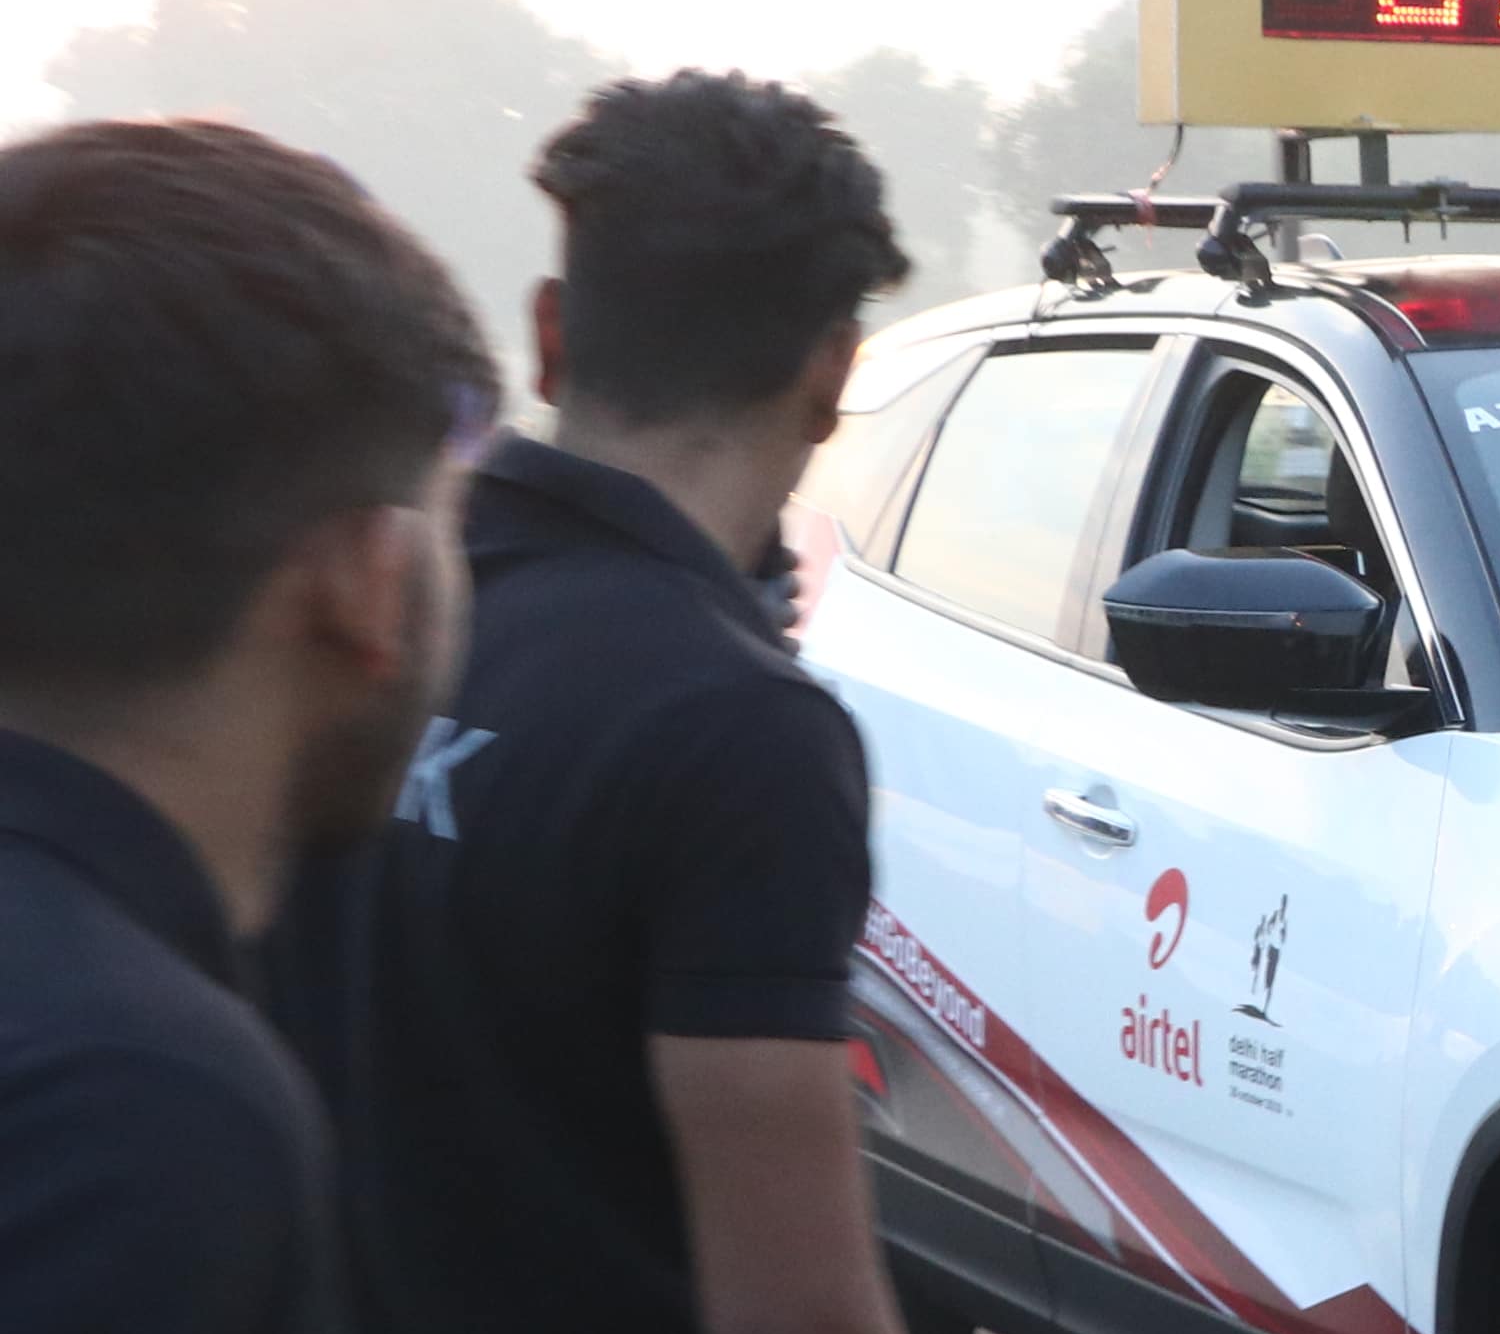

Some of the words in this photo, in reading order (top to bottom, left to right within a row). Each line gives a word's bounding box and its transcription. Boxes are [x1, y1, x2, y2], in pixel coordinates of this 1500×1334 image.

[1119, 993, 1204, 1087] airtel
[1229, 1034, 1258, 1058] delhi
[1260, 1041, 1286, 1068] half
[1228, 1060, 1284, 1091] marathon
